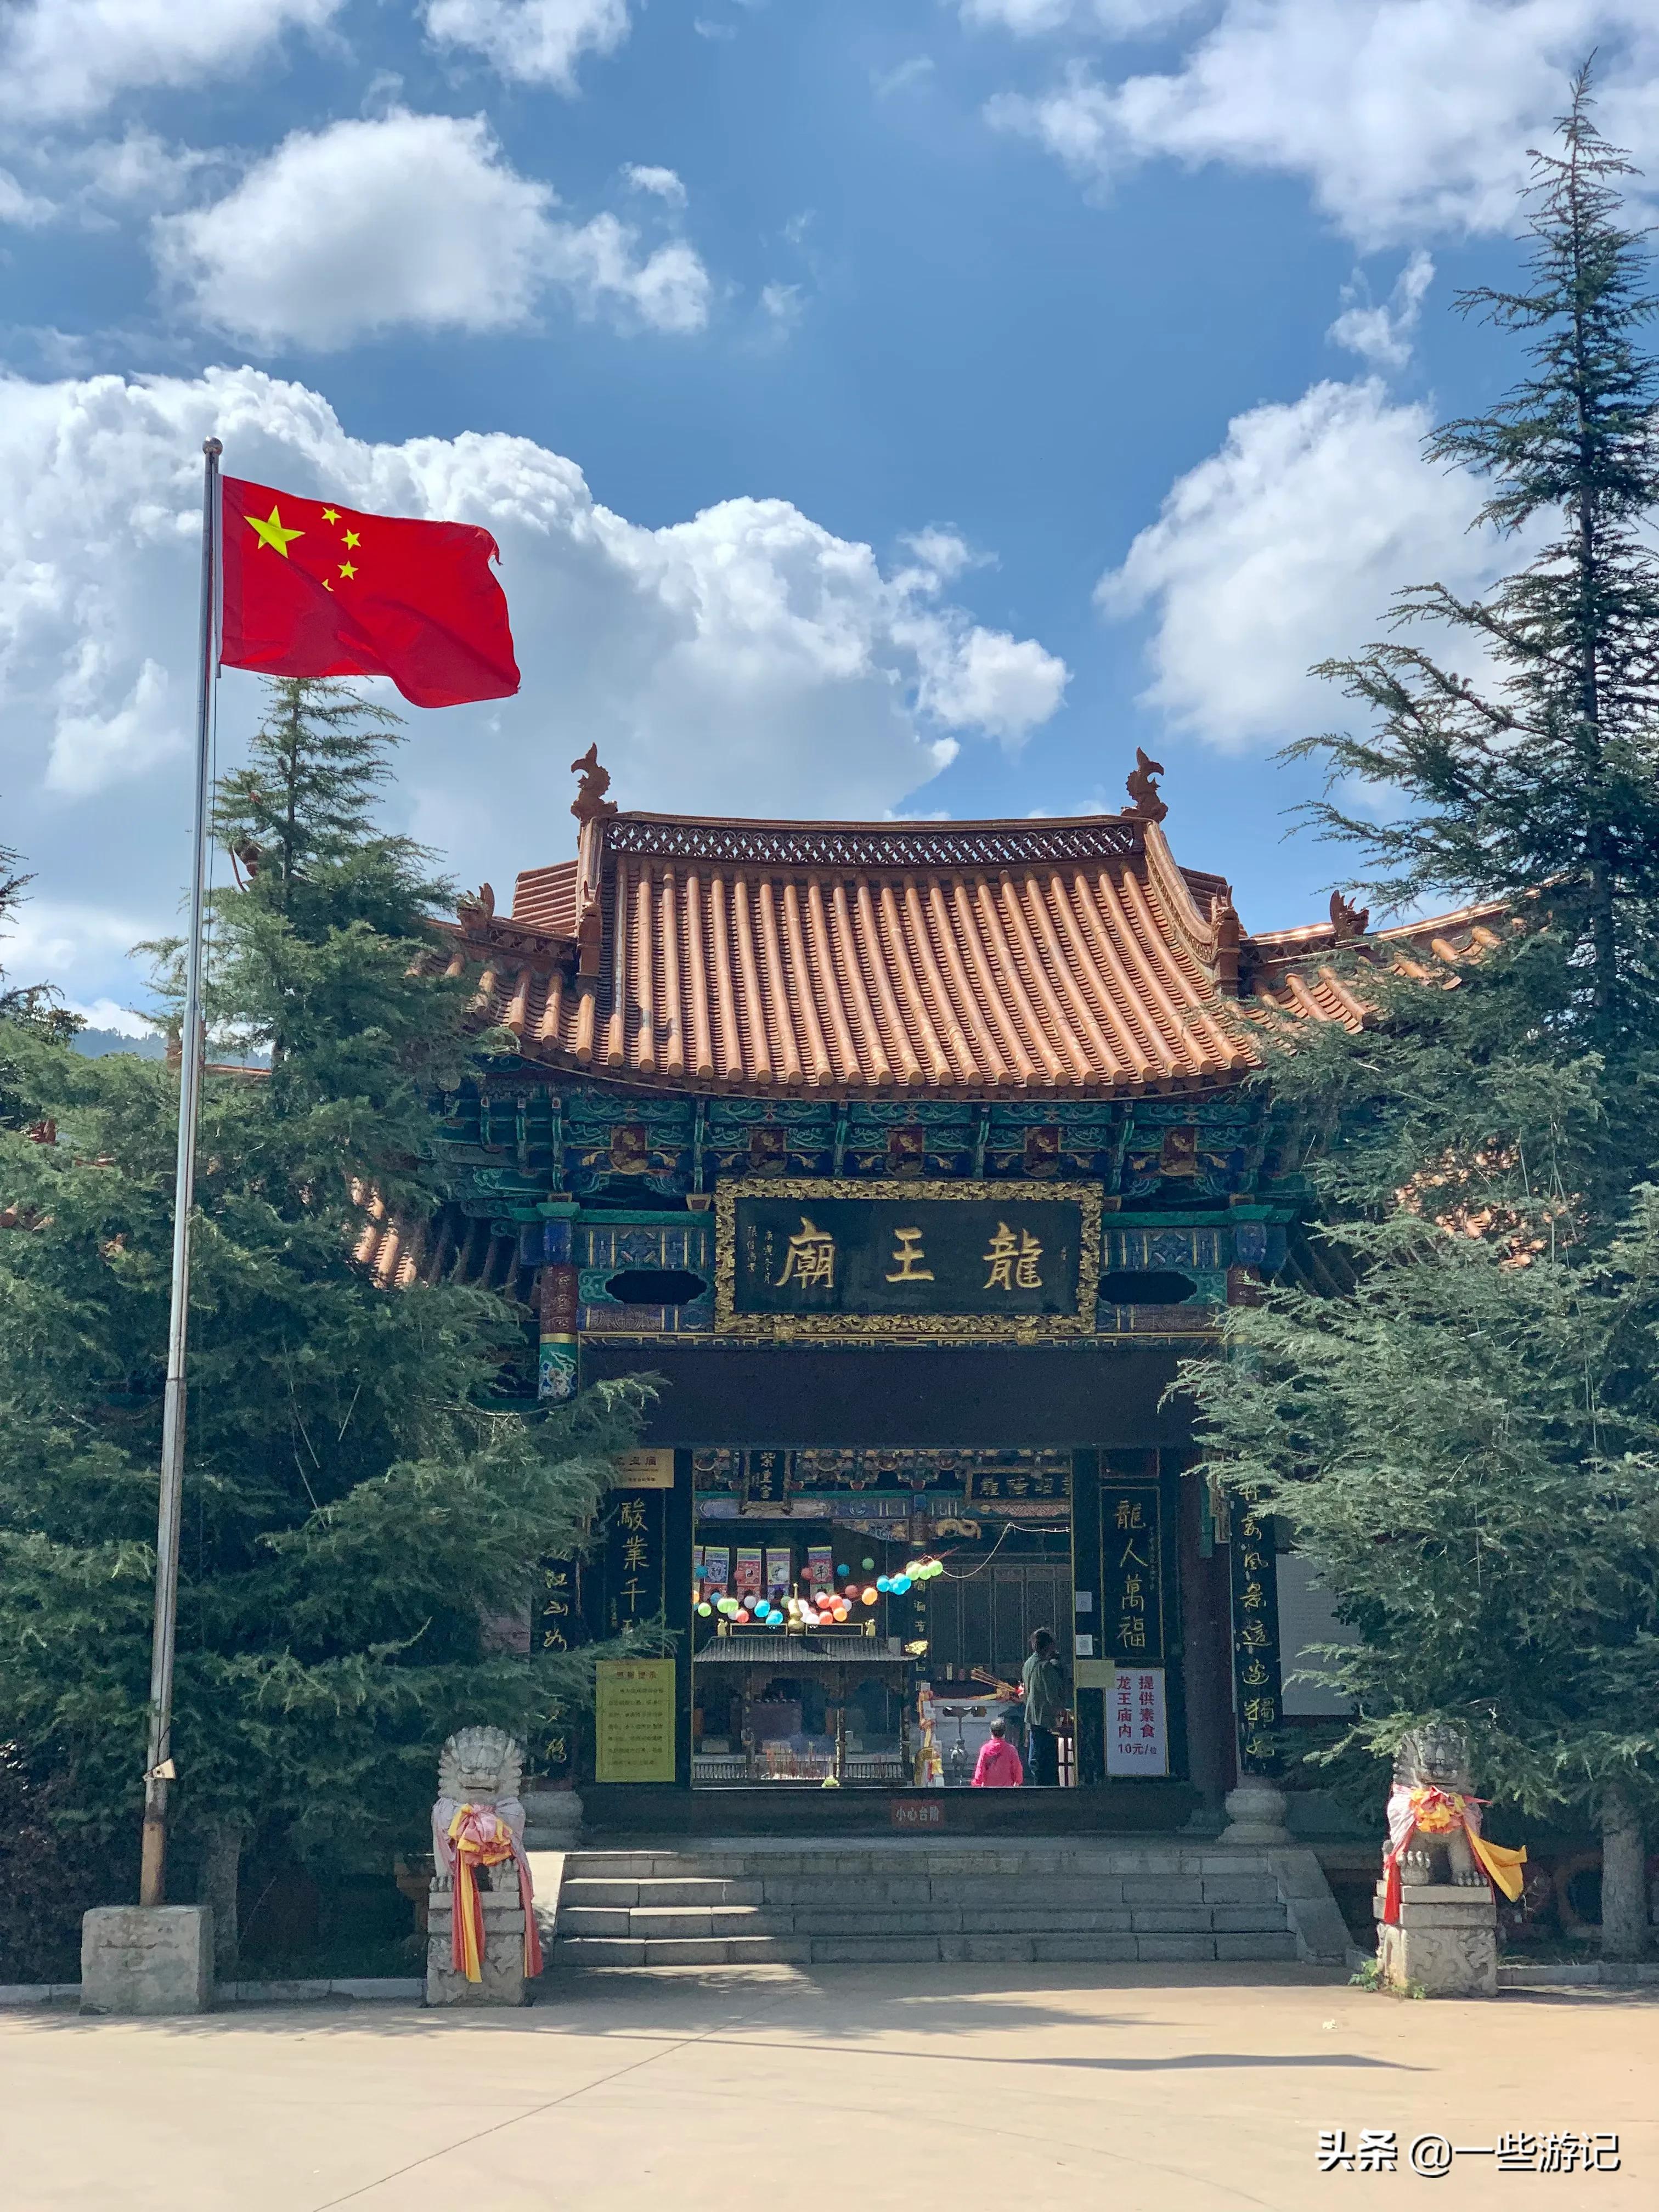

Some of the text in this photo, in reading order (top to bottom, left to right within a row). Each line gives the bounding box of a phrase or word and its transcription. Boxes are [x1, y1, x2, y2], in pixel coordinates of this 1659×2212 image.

[775, 1216, 1045, 1291] 龍王廟
[1116, 1675, 1132, 1739] 龙王庙内
[1138, 1675, 1155, 1738] 提供素食
[895, 1805, 939, 1822] 小心台阶
